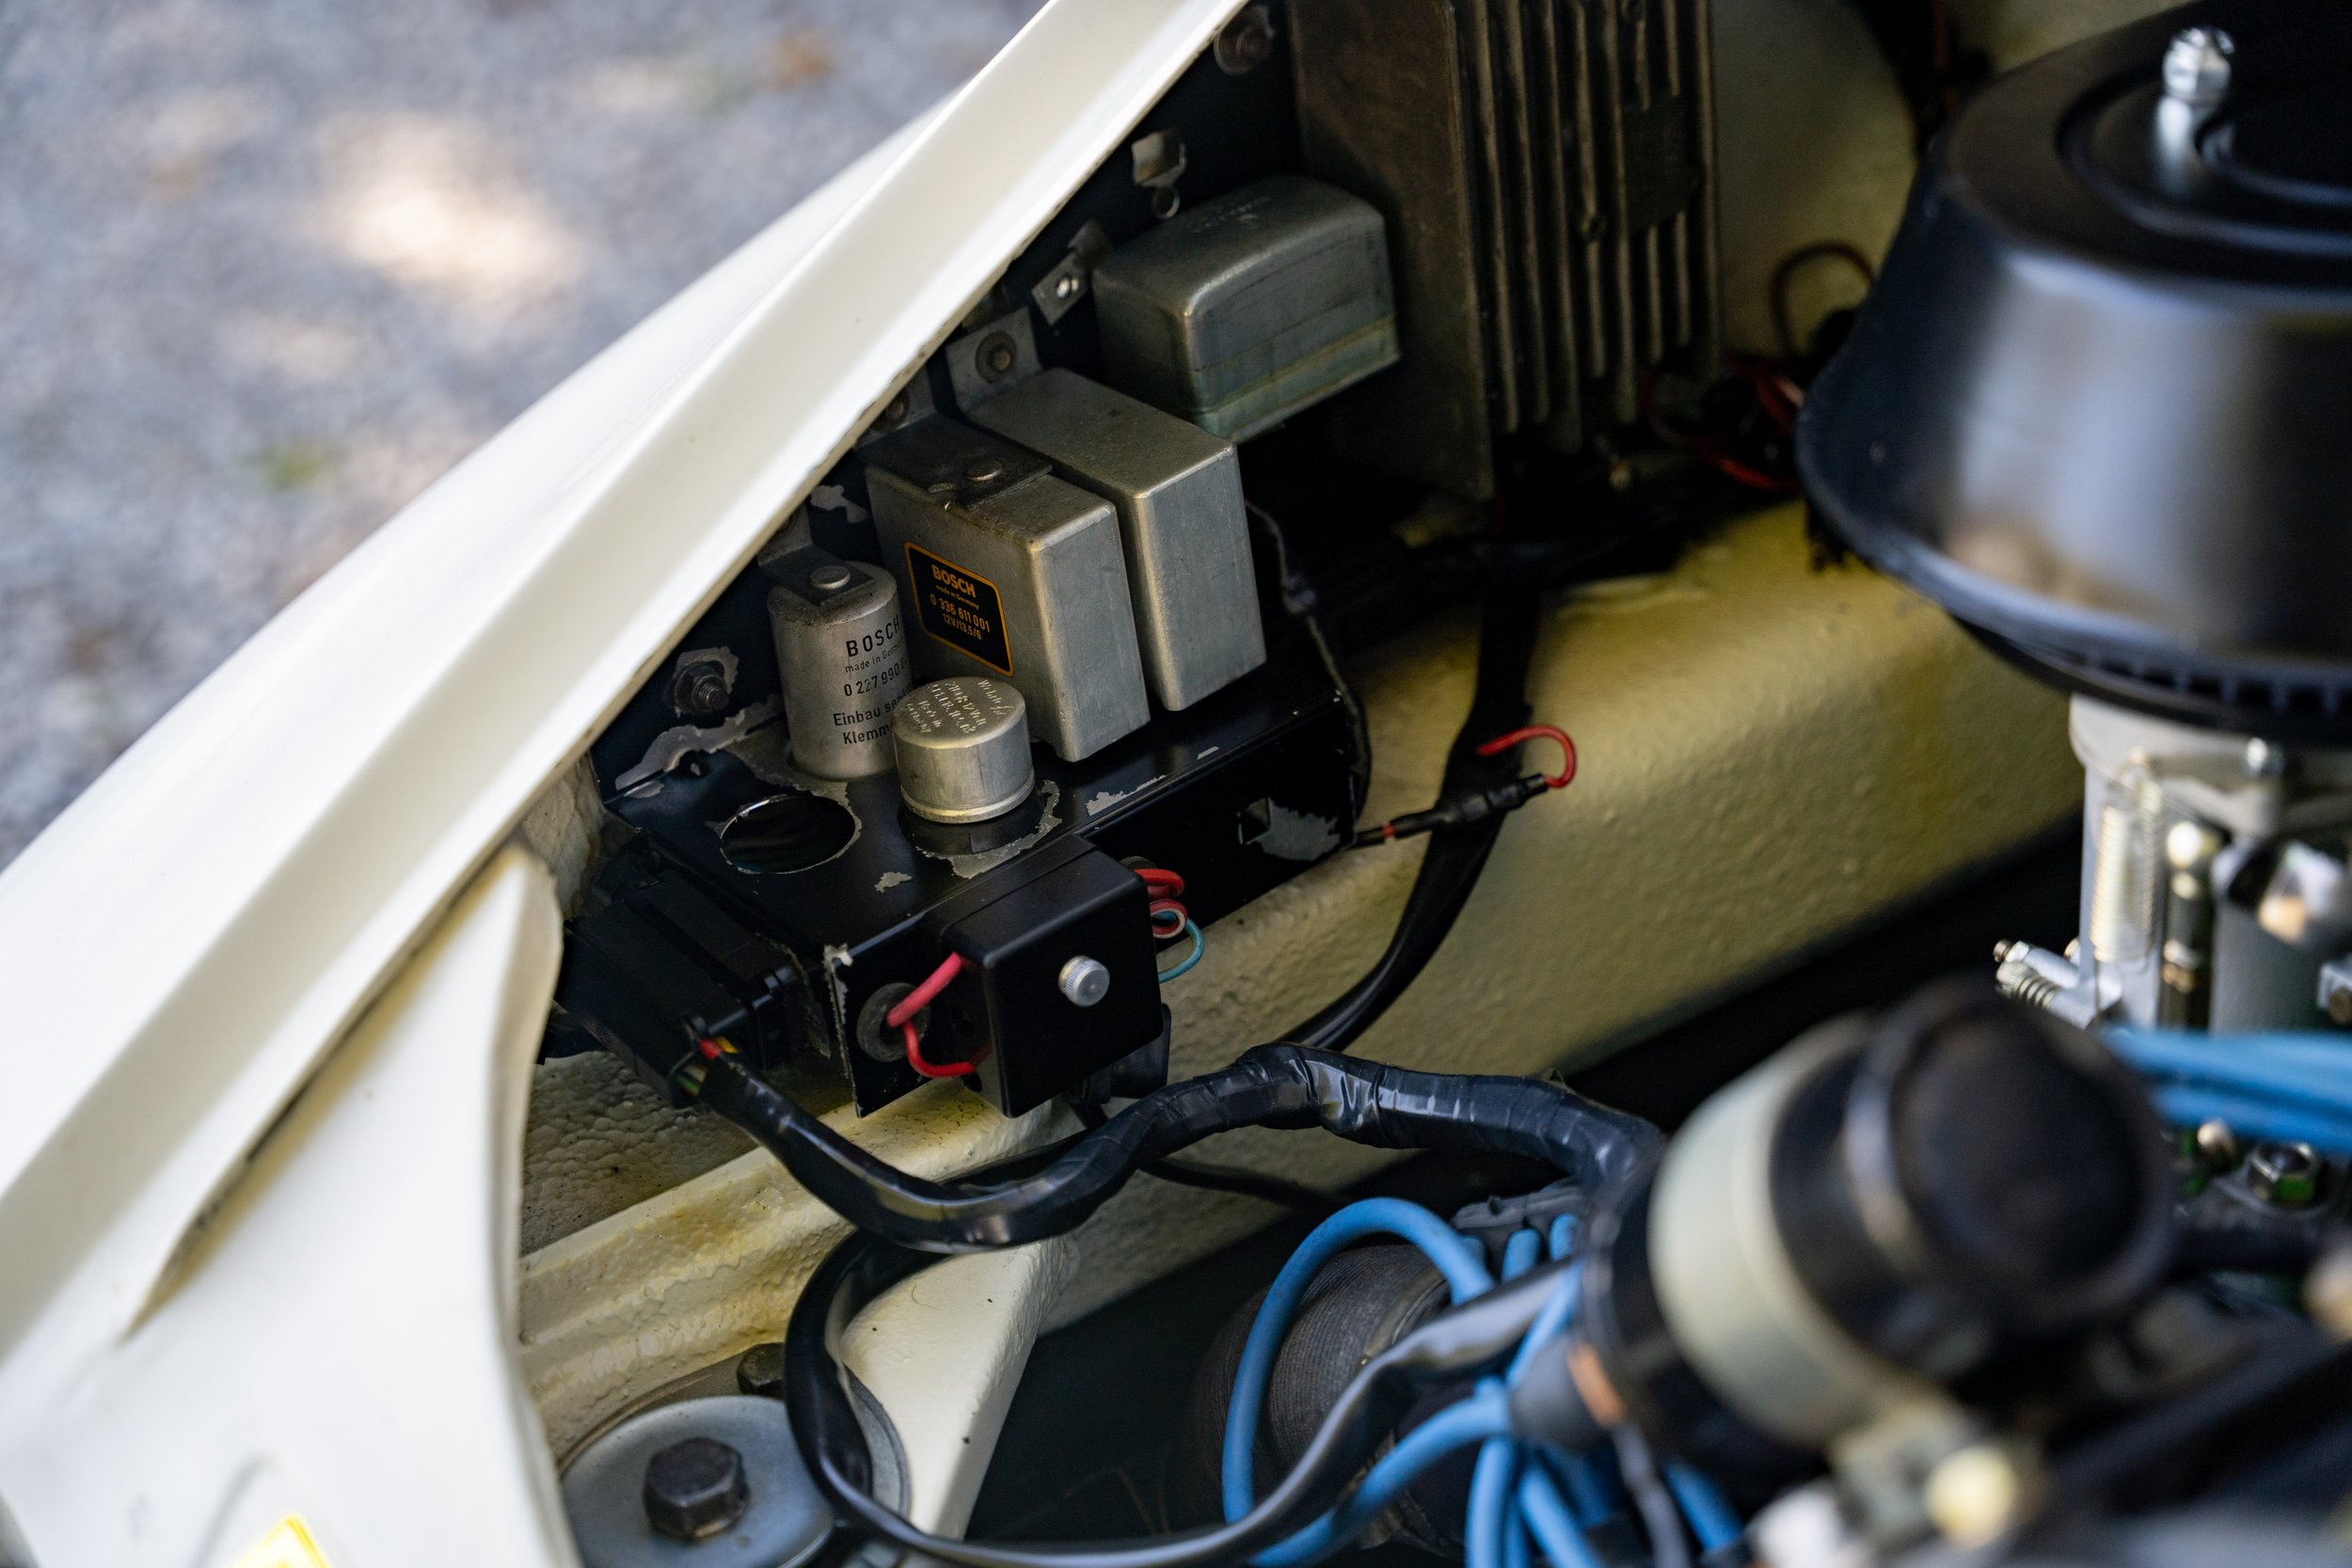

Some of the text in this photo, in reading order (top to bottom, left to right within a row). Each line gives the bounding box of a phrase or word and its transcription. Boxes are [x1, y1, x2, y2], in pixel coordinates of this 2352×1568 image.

[931, 564, 977, 598] BOSCH
[930, 594, 990, 633] 0 336 611 001
[846, 614, 900, 657] BOSCH
[843, 683, 852, 697] 0
[881, 662, 900, 685] 990
[845, 660, 870, 673] made
[872, 656, 882, 666] in
[833, 706, 881, 726] Einbau
[843, 723, 890, 744] Klemm
